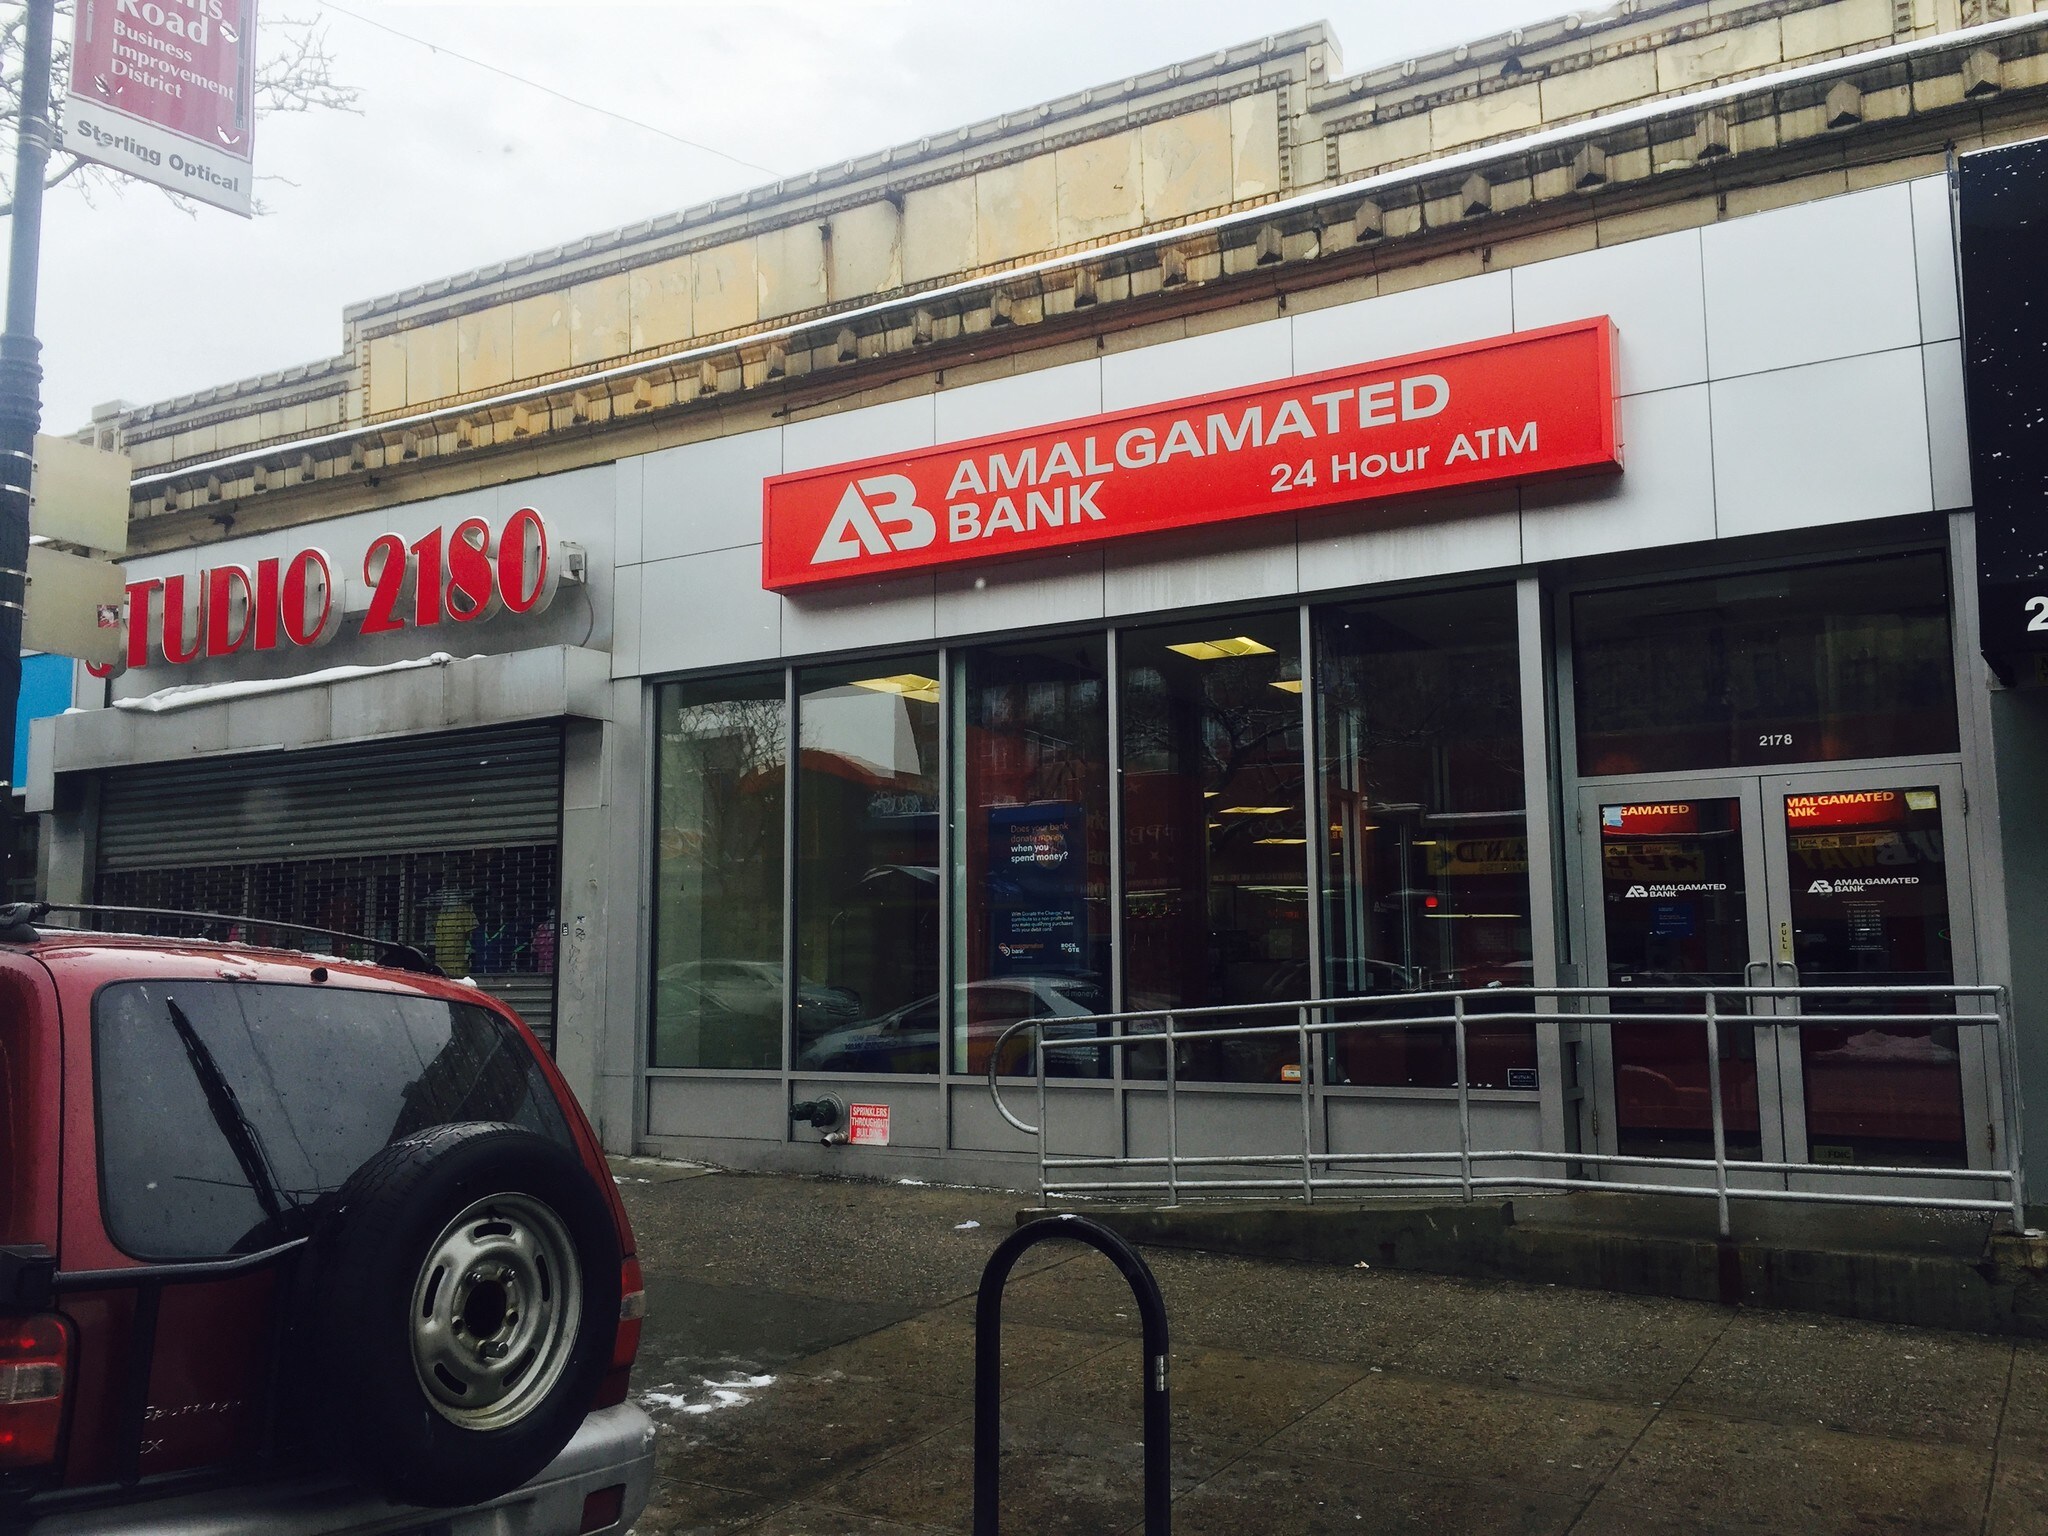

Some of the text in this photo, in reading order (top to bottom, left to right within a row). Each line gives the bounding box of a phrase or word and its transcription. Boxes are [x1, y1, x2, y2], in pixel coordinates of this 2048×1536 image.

[113, 18, 193, 63] Business
[116, 0, 209, 46] Road
[111, 58, 183, 99] District
[112, 39, 235, 102] Improvement
[77, 119, 240, 193] Sterling Optical
[945, 372, 1453, 500] AMALGAMATED
[1269, 421, 1540, 495] 24 Hour ATM
[948, 479, 1106, 544] BANK
[85, 506, 549, 679] TUDIO 2180
[1759, 733, 1793, 747] 2178
[1011, 824, 1030, 833] Does
[1049, 822, 1069, 831] bank
[1011, 844, 1049, 853] when you
[1011, 851, 1069, 864] spend money?
[1649, 883, 1727, 891] AMALGAMATED
[1833, 876, 1920, 886] AMALGAMATED
[851, 1117, 888, 1128] THROUGHOUT
[853, 1106, 888, 1117] SPRINKLERS
